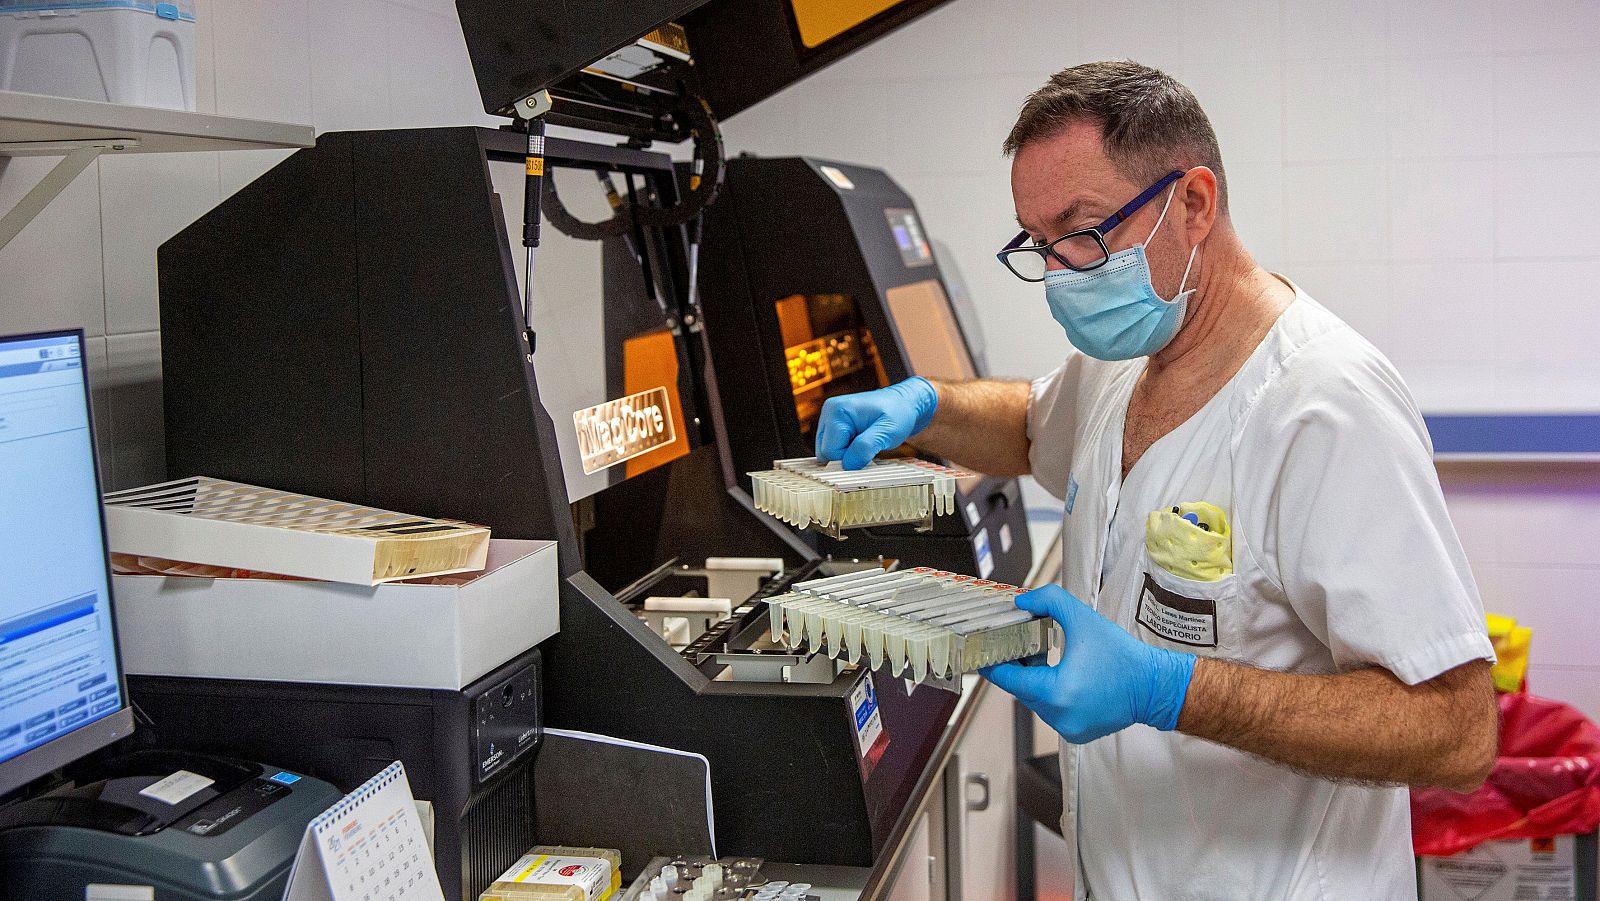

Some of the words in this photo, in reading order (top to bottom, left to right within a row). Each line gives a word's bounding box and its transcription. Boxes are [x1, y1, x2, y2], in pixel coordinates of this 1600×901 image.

[580, 404, 664, 455] MagCore
[1146, 614, 1201, 641] LABORATORIO
[1162, 617, 1207, 632] ESPECIALISTA
